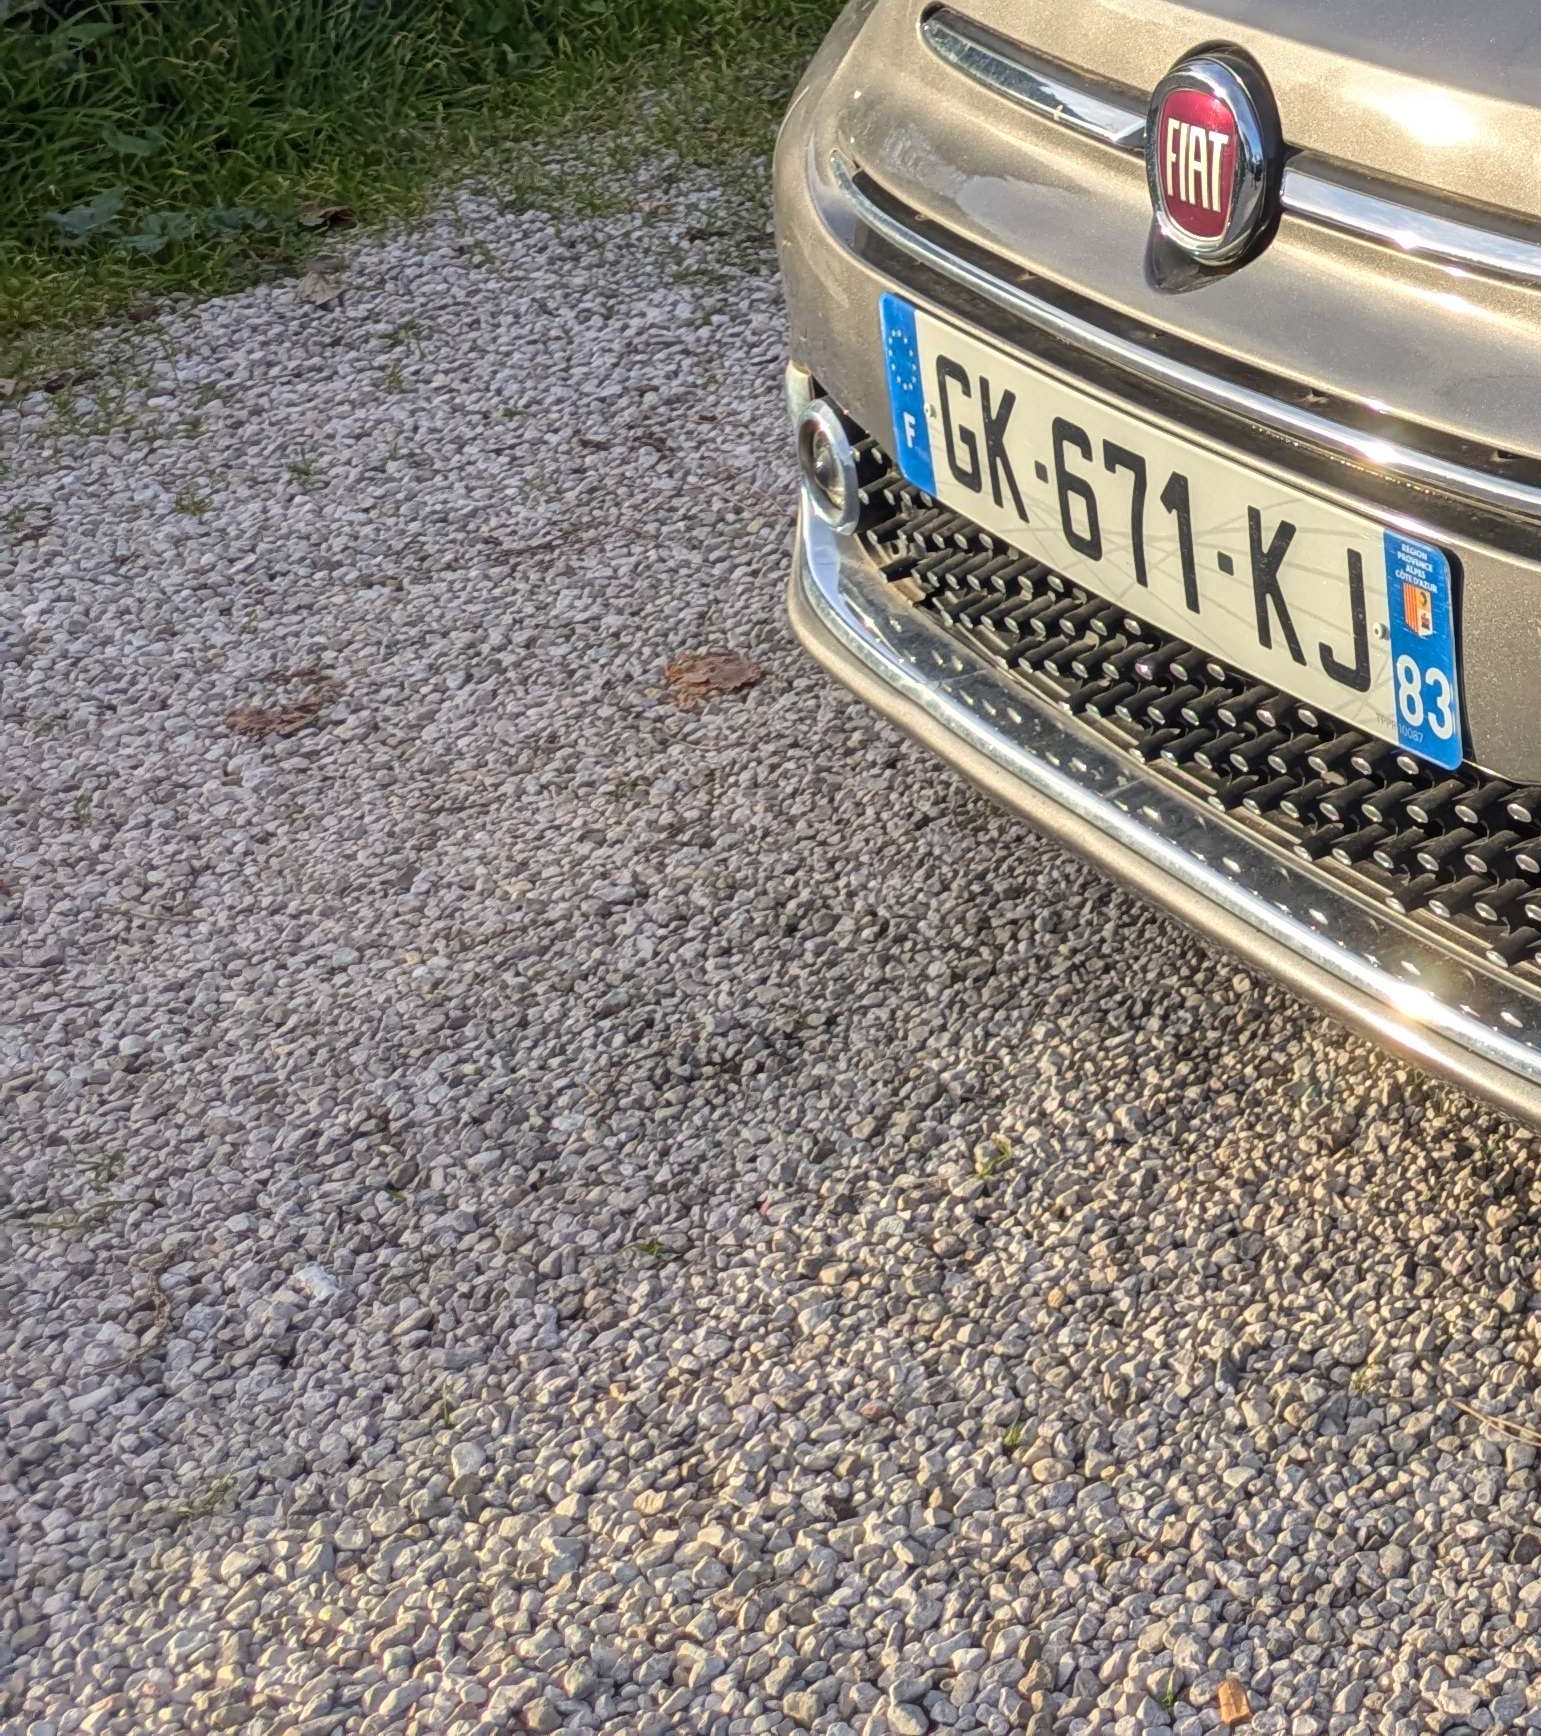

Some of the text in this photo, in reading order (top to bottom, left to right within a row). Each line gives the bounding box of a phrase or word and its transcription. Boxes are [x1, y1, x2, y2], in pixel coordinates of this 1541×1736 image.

[1166, 117, 1230, 213] FIAT
[902, 411, 918, 449] F
[935, 354, 1372, 694] GK-671-KJ
[1396, 654, 1453, 740] 83
